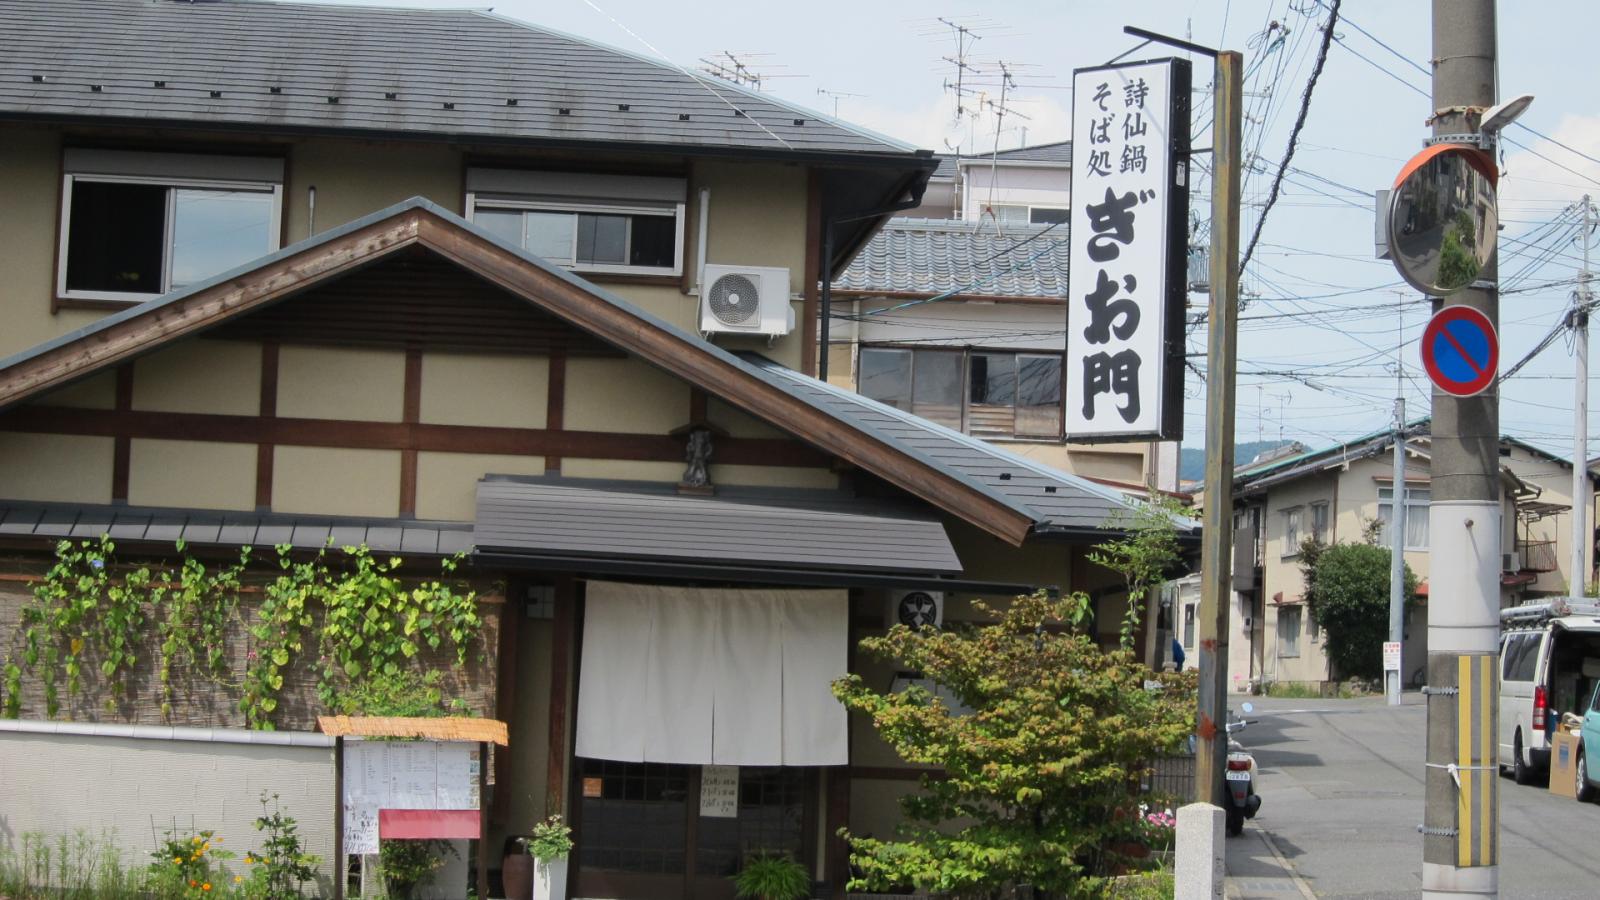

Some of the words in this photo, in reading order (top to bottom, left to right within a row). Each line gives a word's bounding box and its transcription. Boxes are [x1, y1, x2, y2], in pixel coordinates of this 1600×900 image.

[1086, 82, 1114, 178] そば処
[1120, 79, 1149, 174] 詩仙鍋
[1082, 187, 1155, 424] ぎお門
